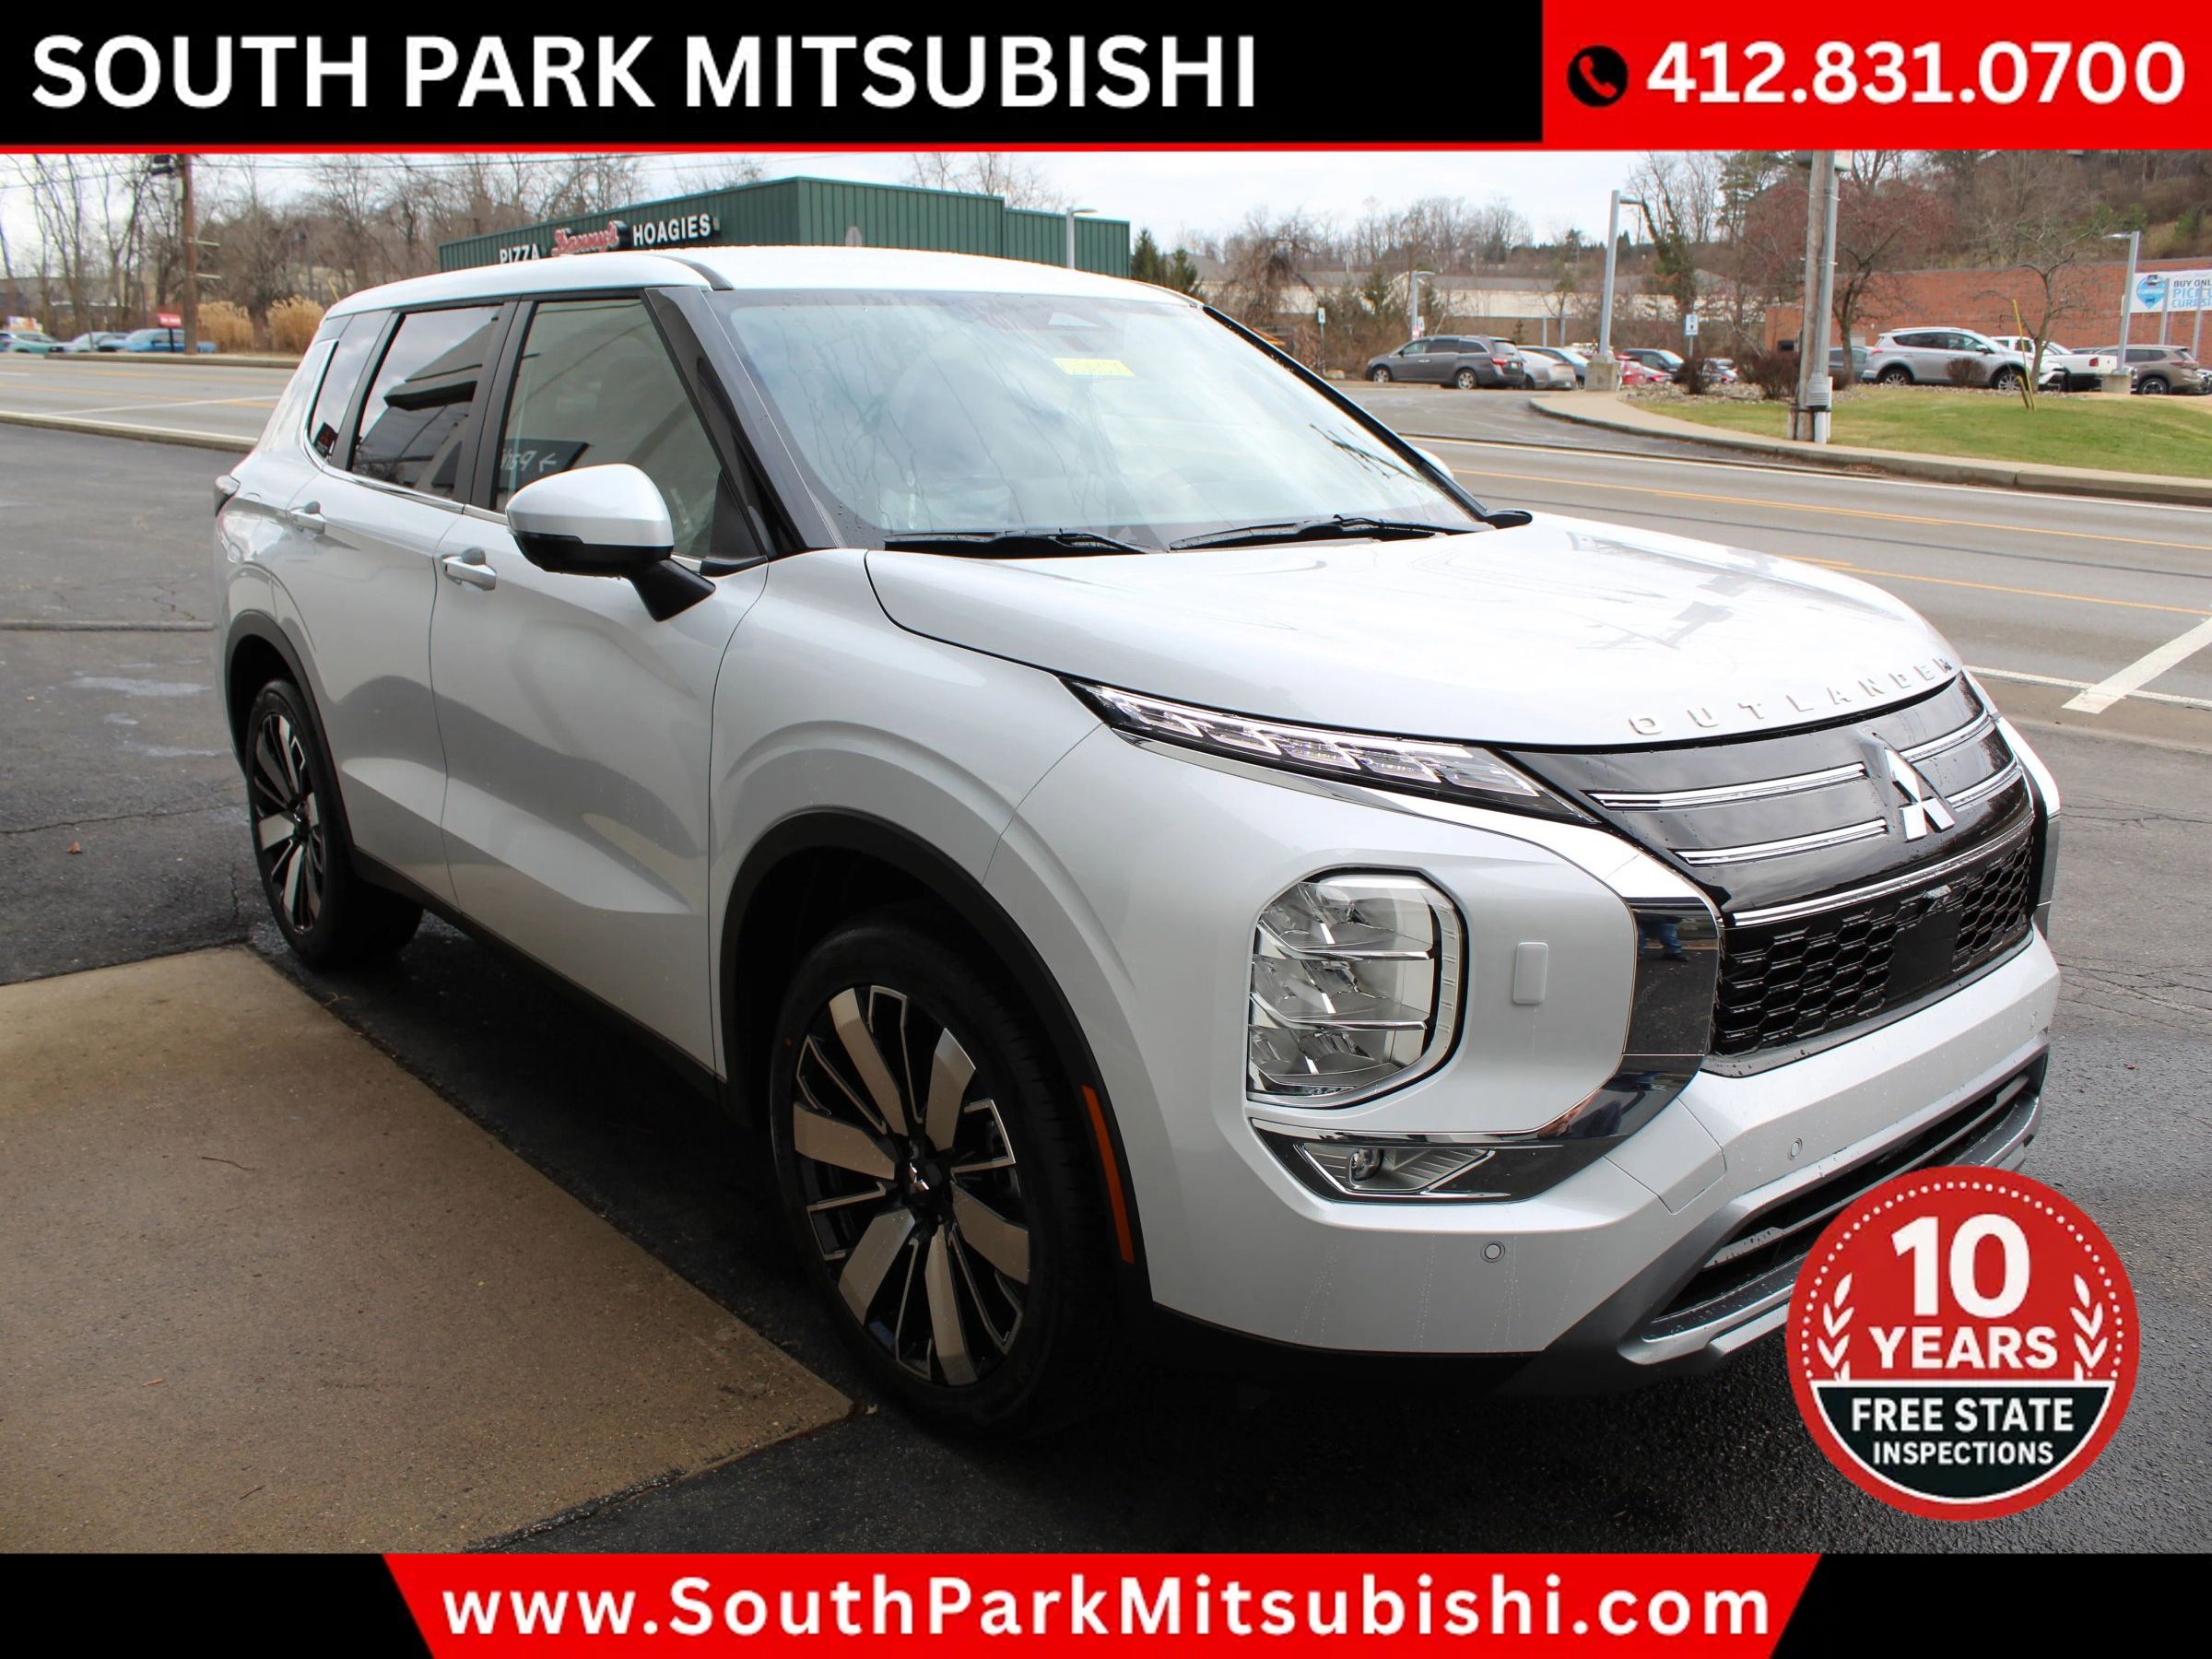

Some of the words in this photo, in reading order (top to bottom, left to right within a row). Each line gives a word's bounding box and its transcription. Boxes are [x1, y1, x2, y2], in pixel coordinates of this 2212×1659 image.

[499, 243, 540, 264] PIZZA
[633, 214, 712, 247] HOAGIES
[1629, 657, 1953, 735] OUTLANDER
